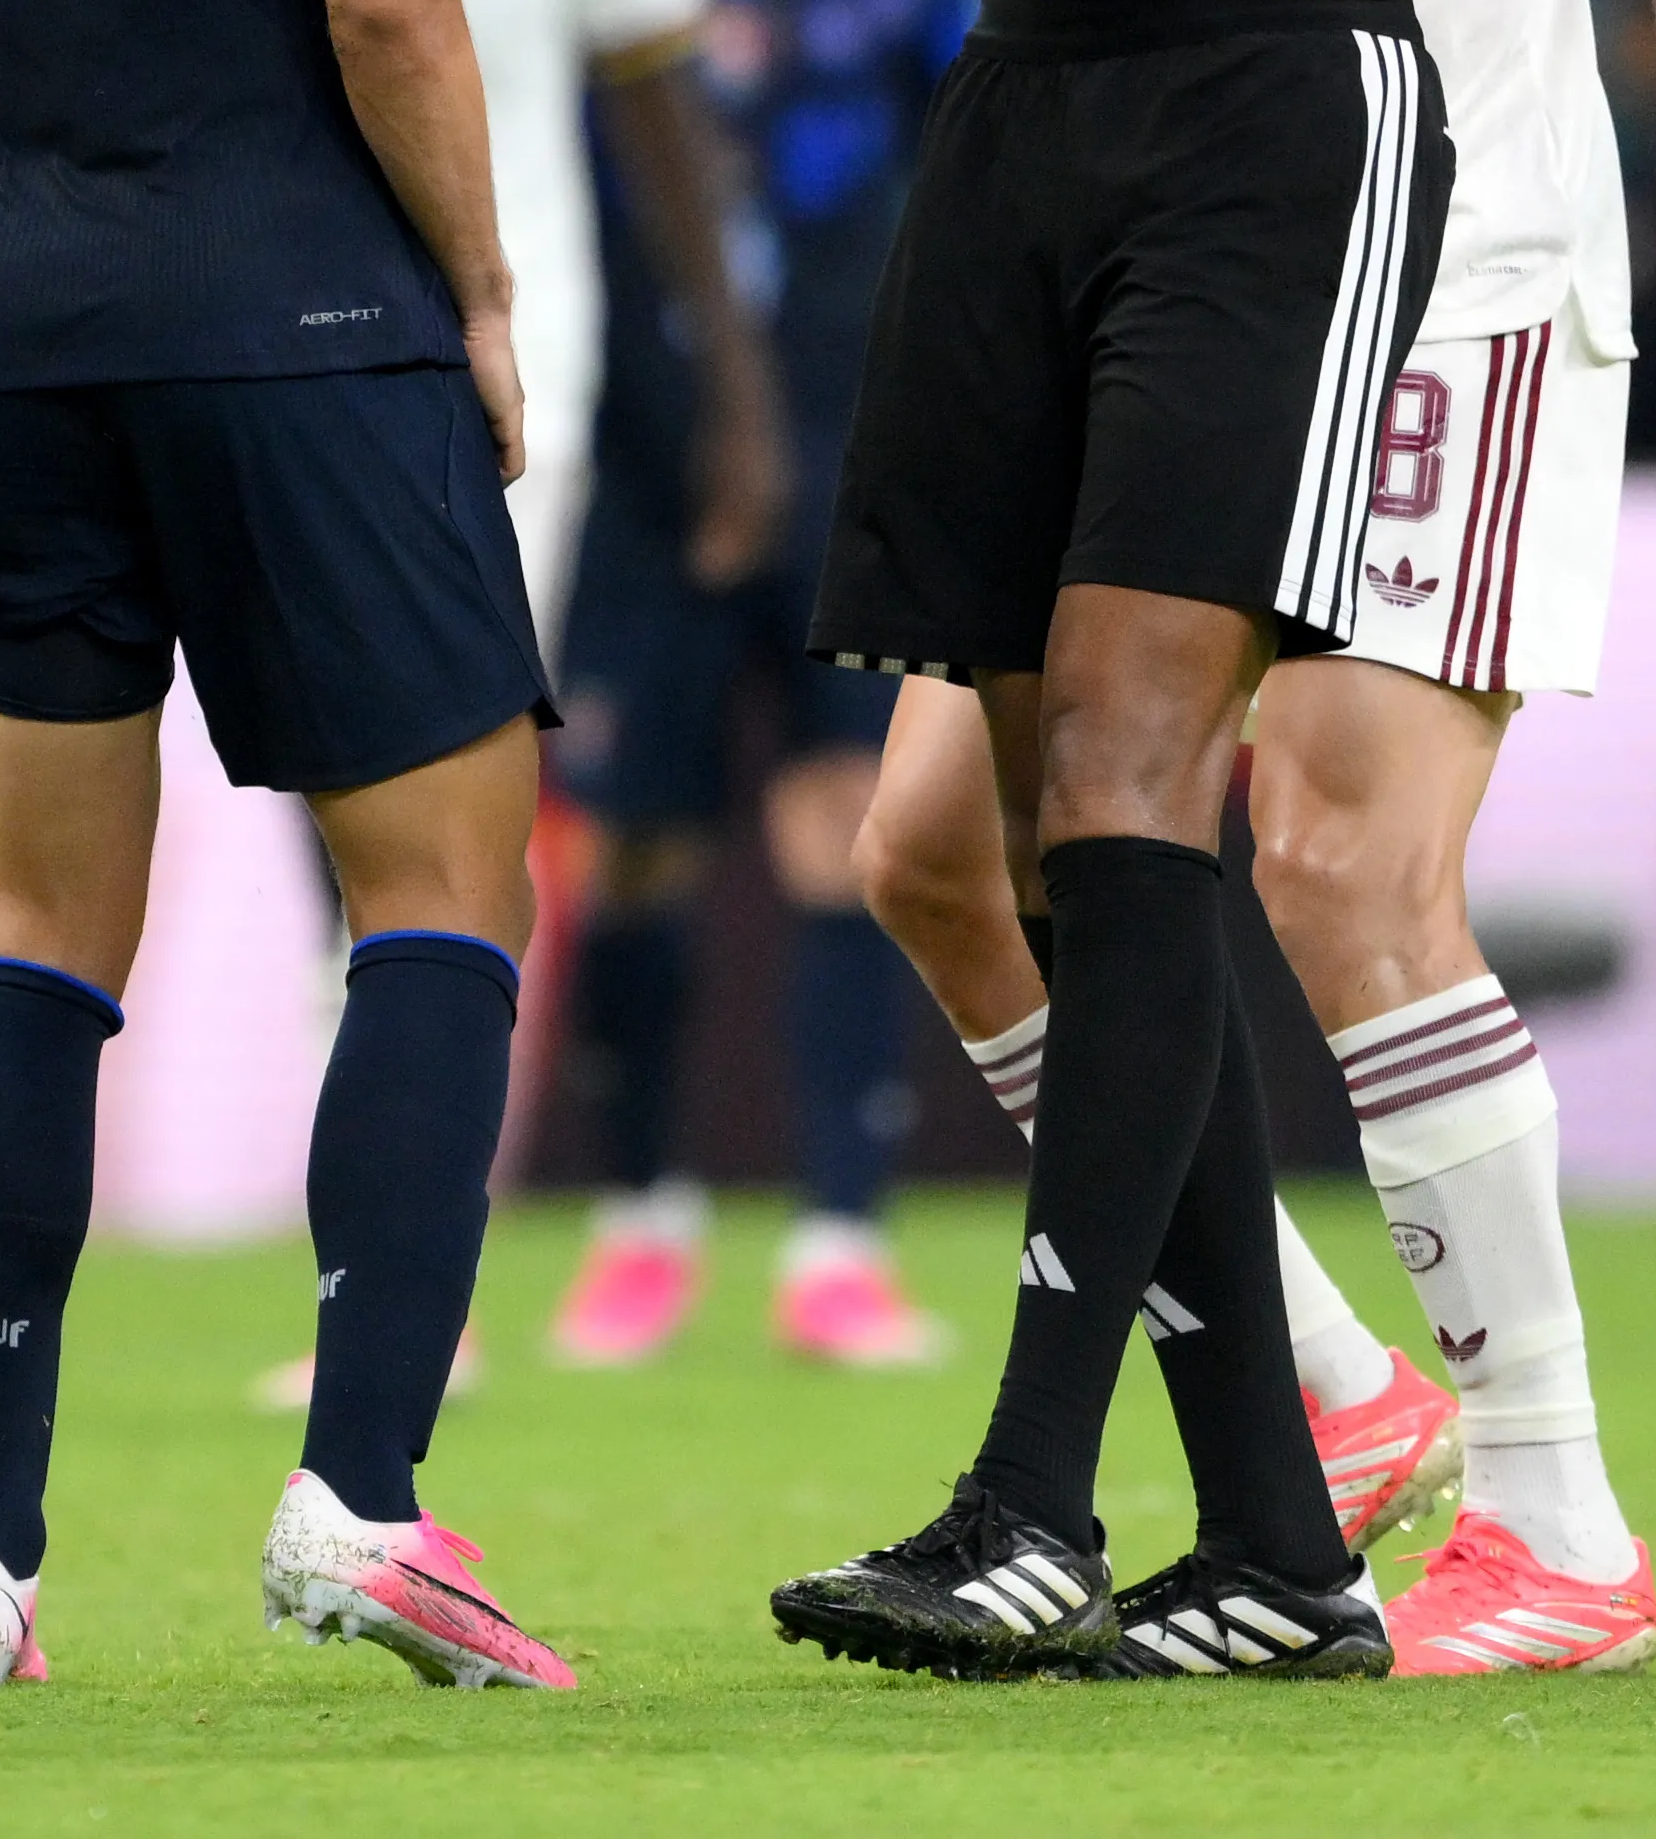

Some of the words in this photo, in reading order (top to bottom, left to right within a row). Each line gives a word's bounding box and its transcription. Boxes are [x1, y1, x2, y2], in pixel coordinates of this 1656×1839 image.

[299, 307, 383, 327] AERO-FIT
[1369, 369, 1452, 523] 8
[318, 1267, 347, 1302] UF
